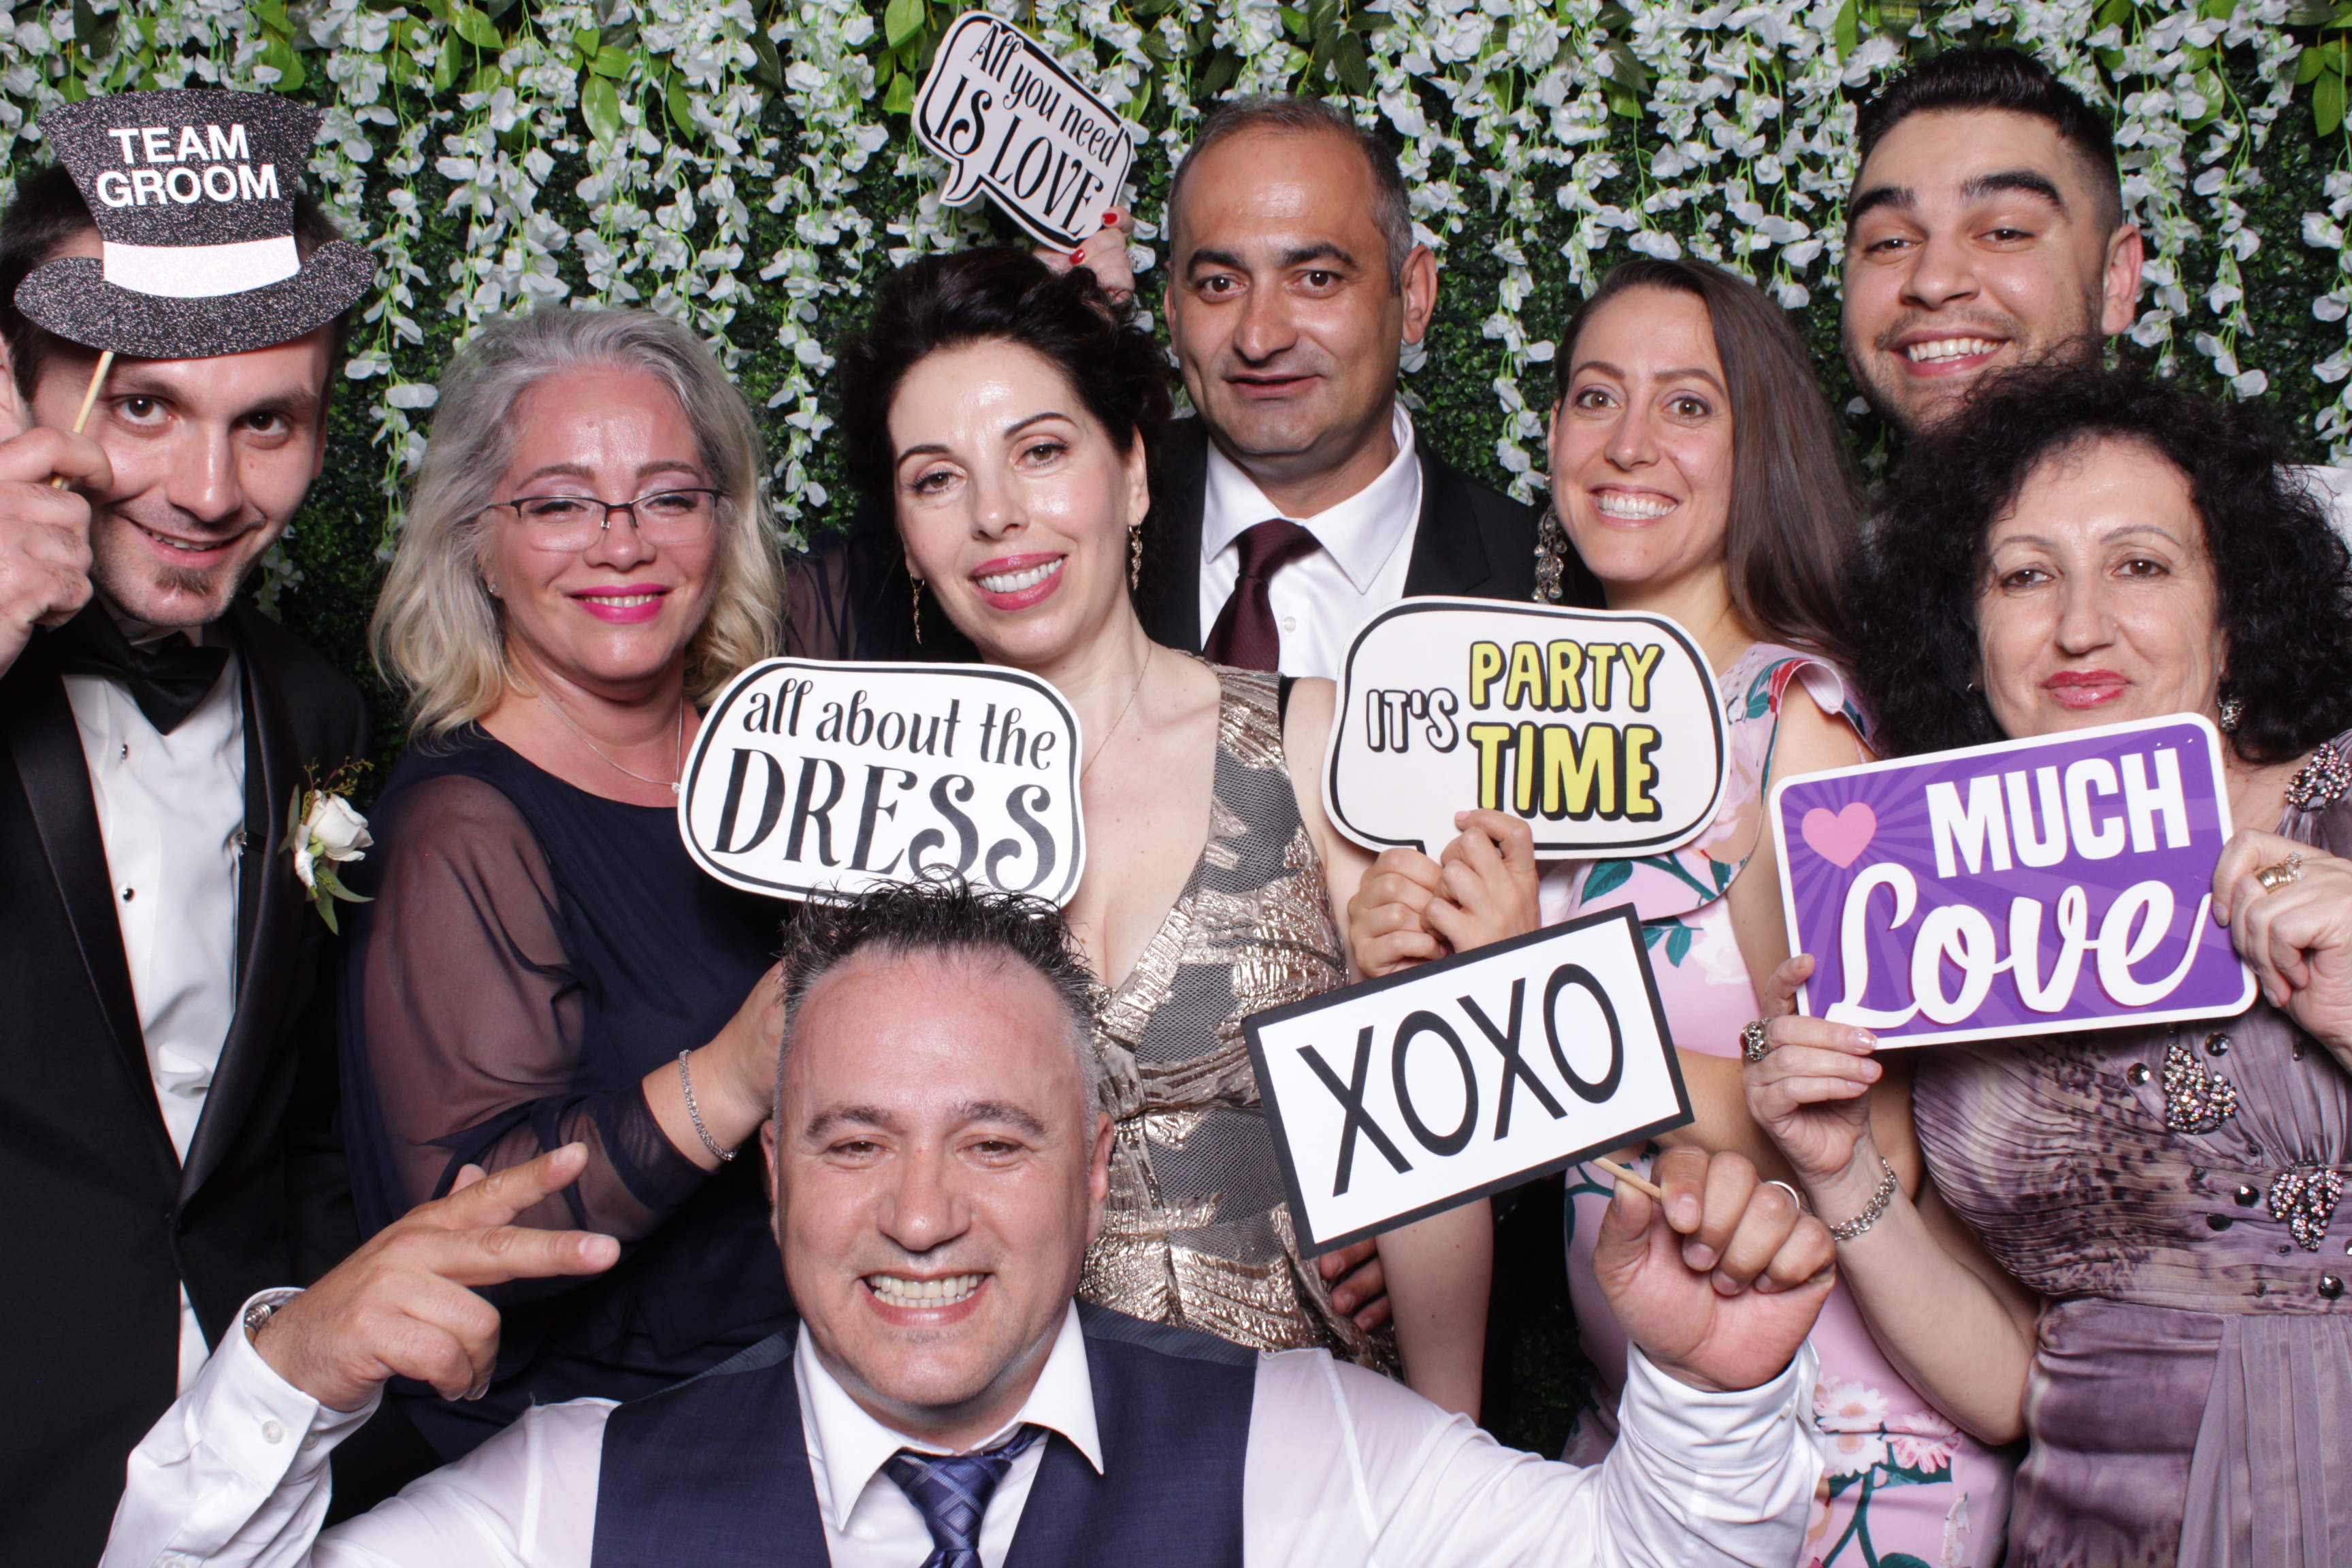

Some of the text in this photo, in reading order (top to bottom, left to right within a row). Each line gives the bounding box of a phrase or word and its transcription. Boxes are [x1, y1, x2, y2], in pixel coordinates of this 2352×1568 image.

[109, 124, 250, 164] TEAM
[968, 24, 1125, 168] All you need
[96, 164, 280, 208] GROOM
[933, 74, 1105, 238] IS LOVE
[742, 678, 1056, 770] all about the
[1366, 687, 1458, 753] IT'S
[1469, 638, 1665, 713] PARTY
[711, 747, 1056, 893] DRESS
[1467, 721, 1663, 822] TIME
[1925, 747, 2191, 879] MUCH
[1824, 862, 2213, 1030] Love
[1296, 962, 1624, 1198] XOXO
